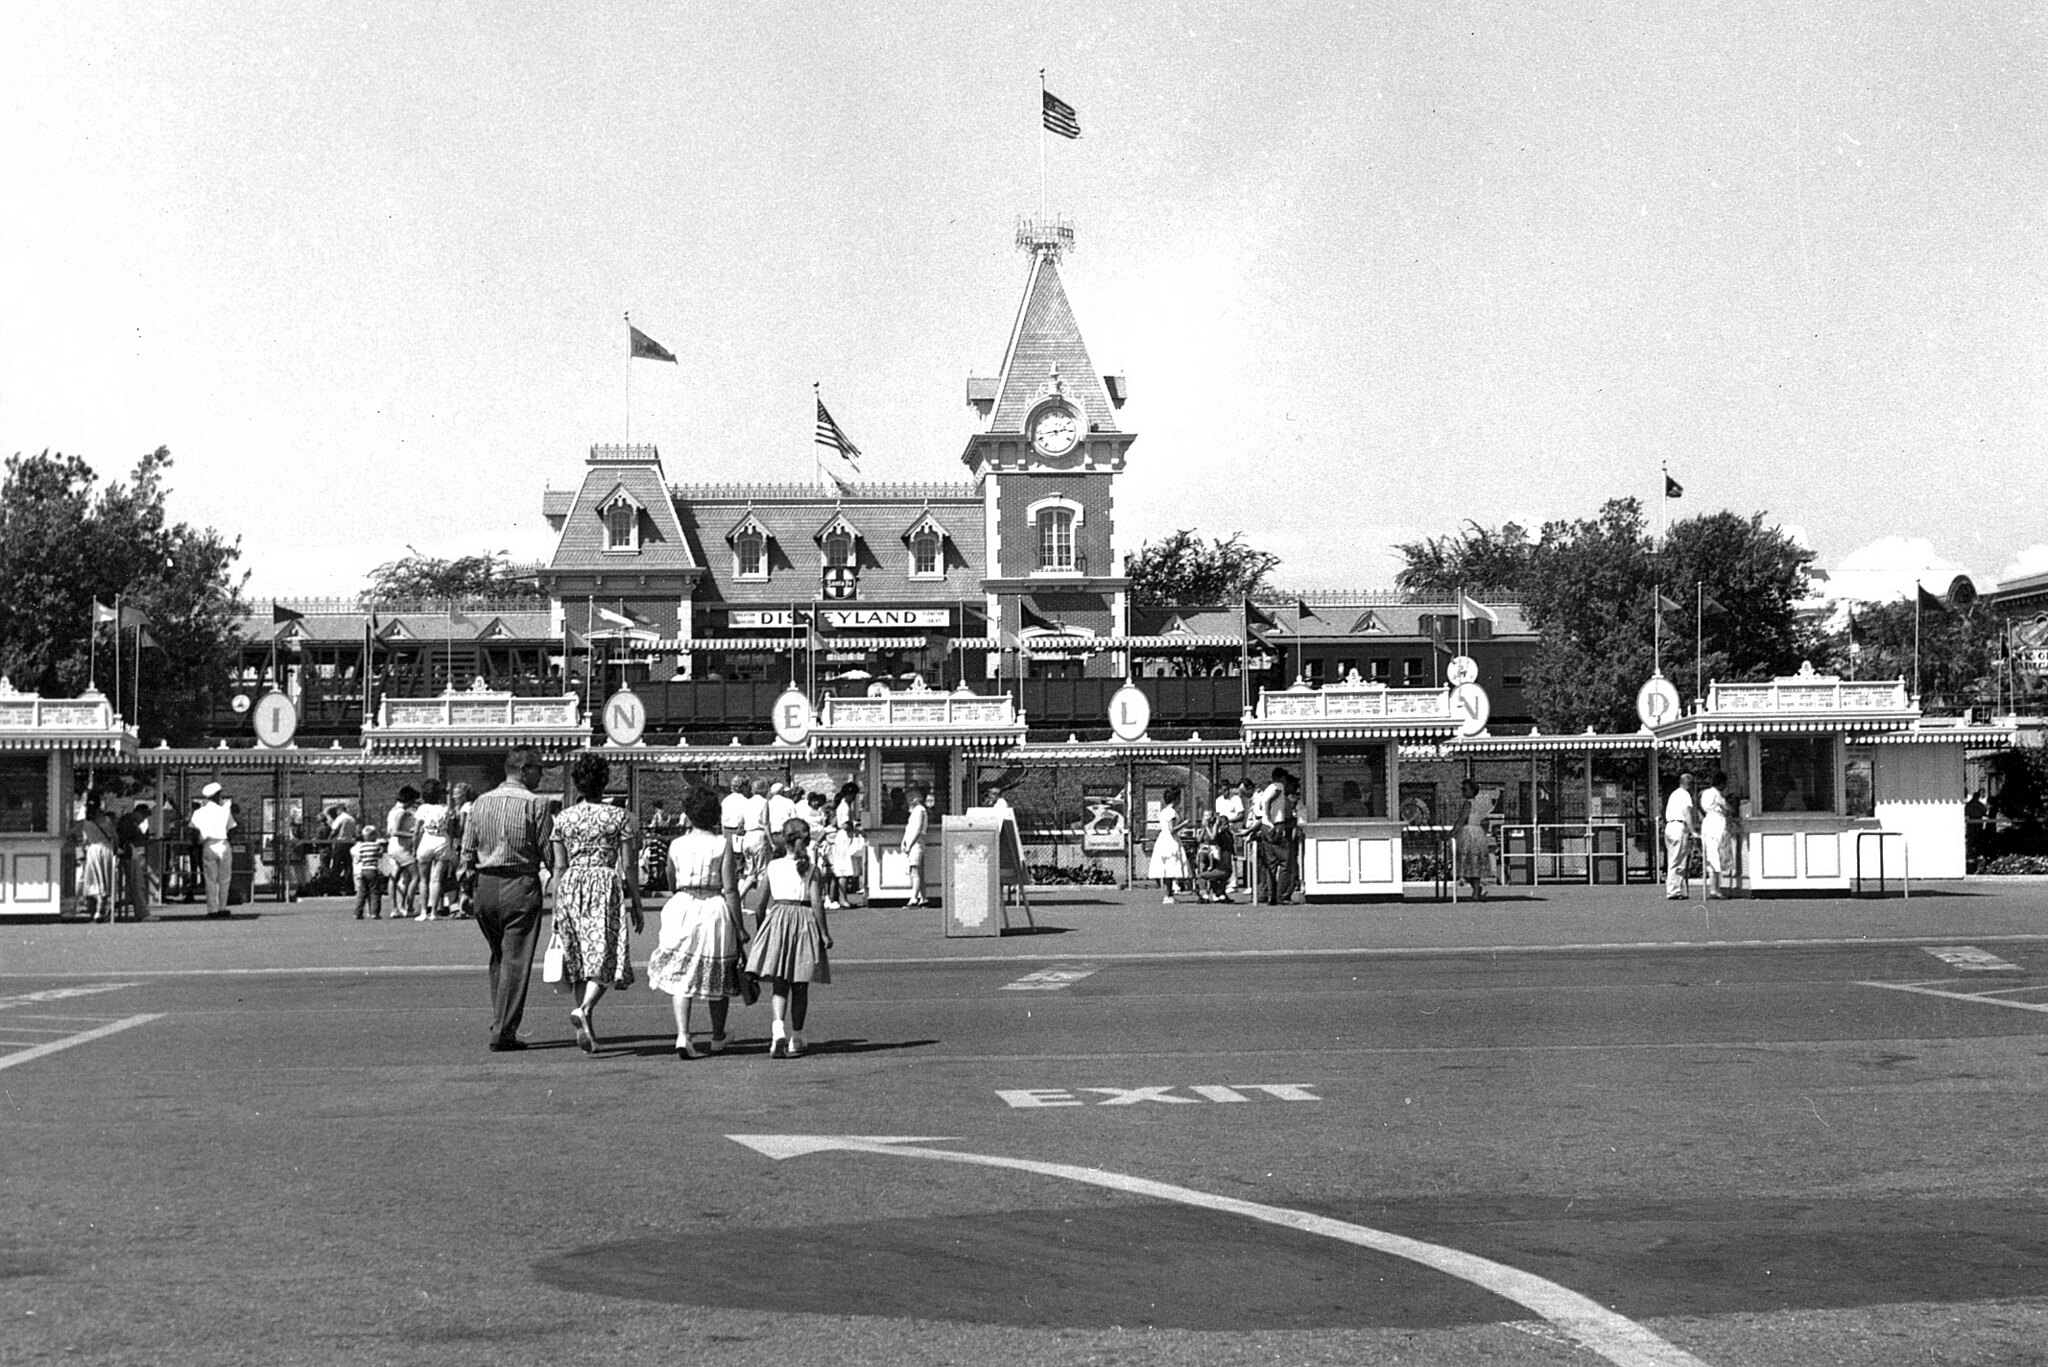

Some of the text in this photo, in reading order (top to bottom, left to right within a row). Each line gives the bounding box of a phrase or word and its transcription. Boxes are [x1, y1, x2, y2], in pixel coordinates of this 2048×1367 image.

[762, 611, 917, 625] DISEYLAND
[613, 704, 636, 729] N
[784, 704, 802, 729] E
[1121, 702, 1137, 725] L
[1457, 696, 1479, 720] N
[1648, 693, 1670, 717] D
[272, 708, 280, 733] I
[994, 1083, 1323, 1108] EXIT
